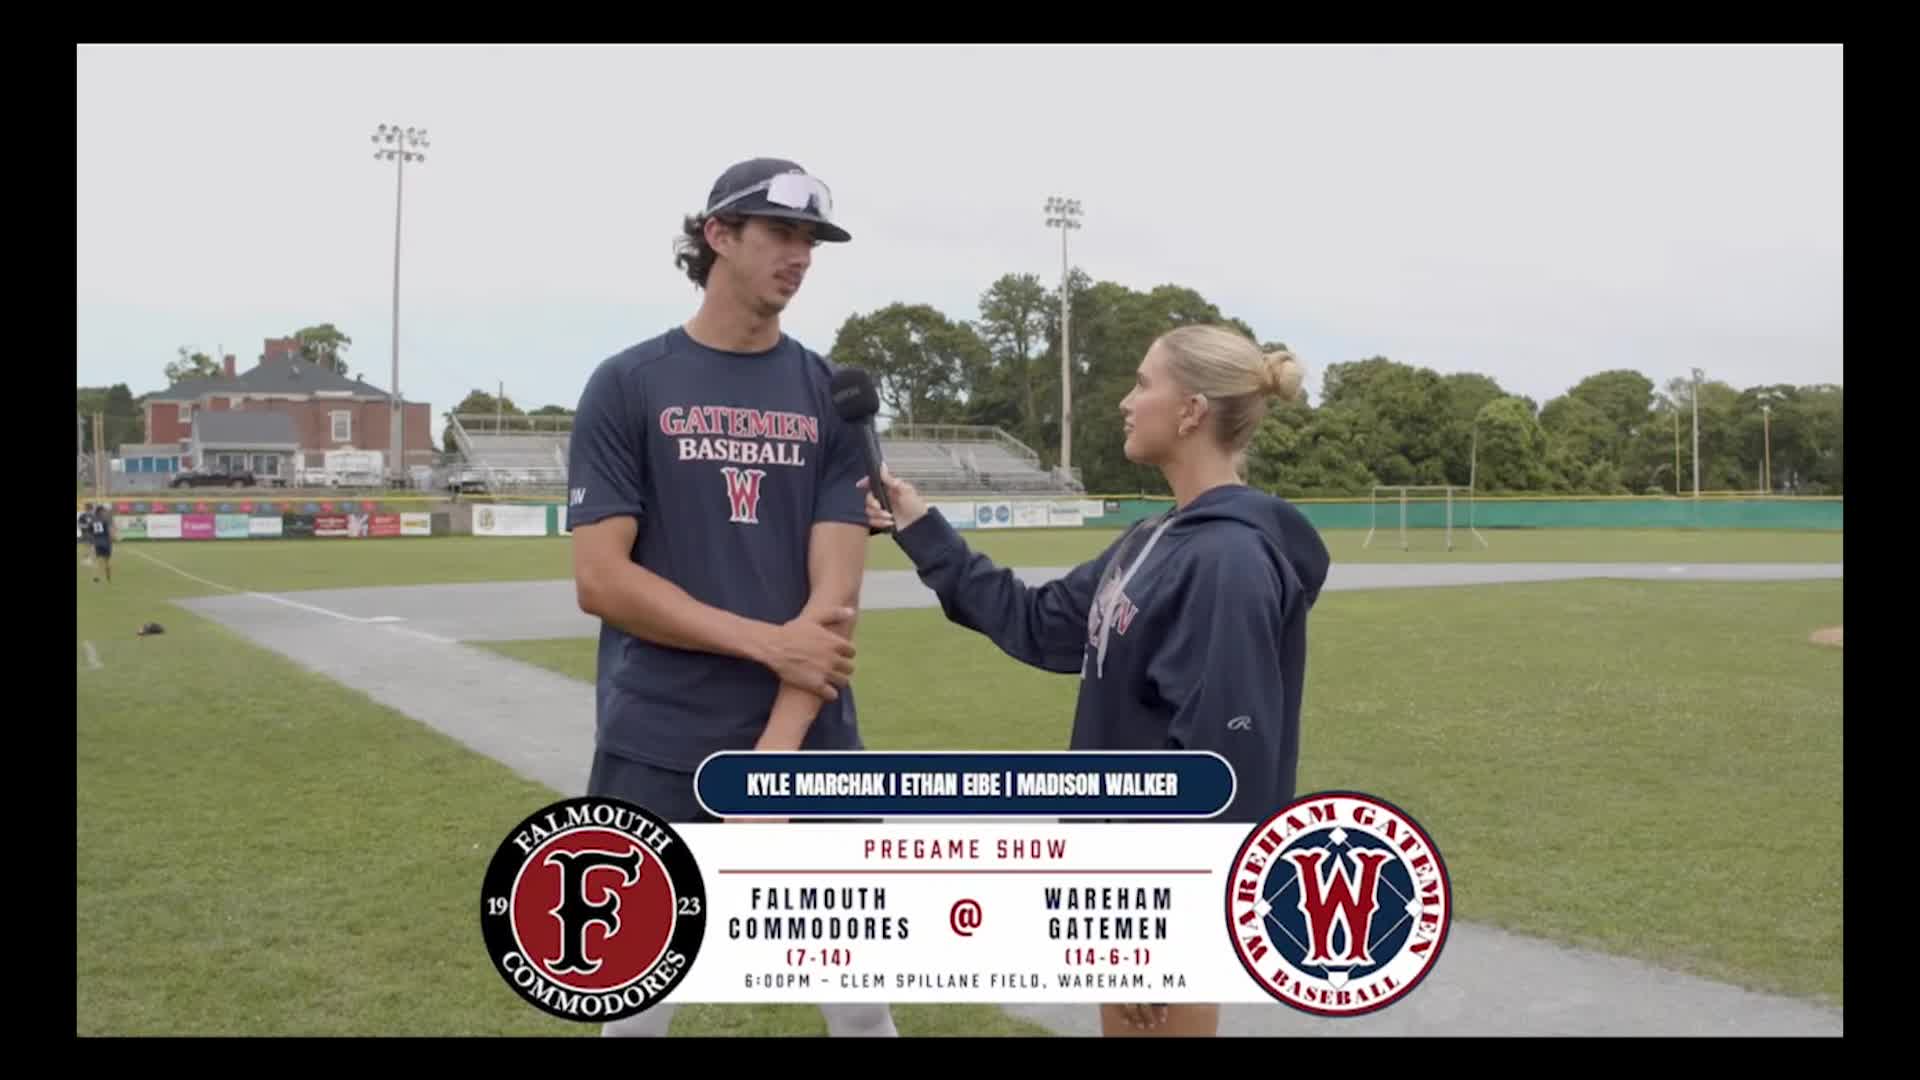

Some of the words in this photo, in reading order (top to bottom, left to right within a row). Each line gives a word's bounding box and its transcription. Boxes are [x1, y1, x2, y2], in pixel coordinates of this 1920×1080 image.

[660, 406, 818, 444] GATEMEN
[678, 438, 805, 466] BASEBALL
[721, 467, 766, 523] W
